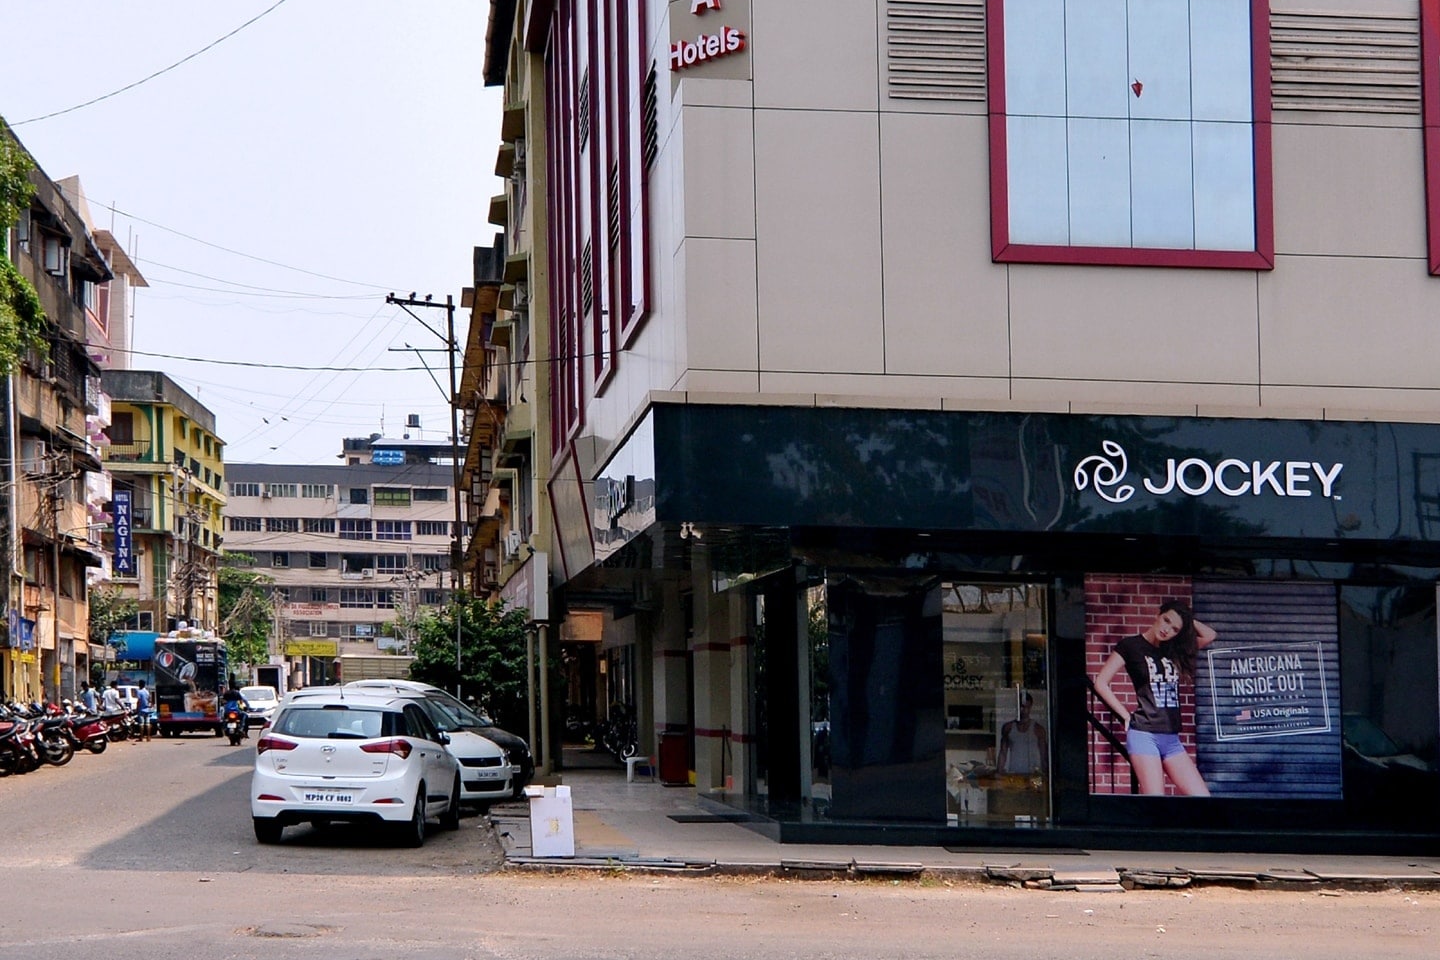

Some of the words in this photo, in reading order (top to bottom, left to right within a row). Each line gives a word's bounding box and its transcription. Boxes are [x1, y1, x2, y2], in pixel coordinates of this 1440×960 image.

[669, 25, 743, 71] Hotels
[1143, 458, 1343, 497] JOCKEY
[117, 504, 129, 569] NAGINA
[1230, 653, 1302, 676] AMERICANA
[944, 675, 984, 685] OCKEY
[1231, 676, 1276, 696] INSIDE
[1277, 673, 1305, 692] OUT
[1253, 709, 1272, 718] USA
[1272, 706, 1309, 718] Originals
